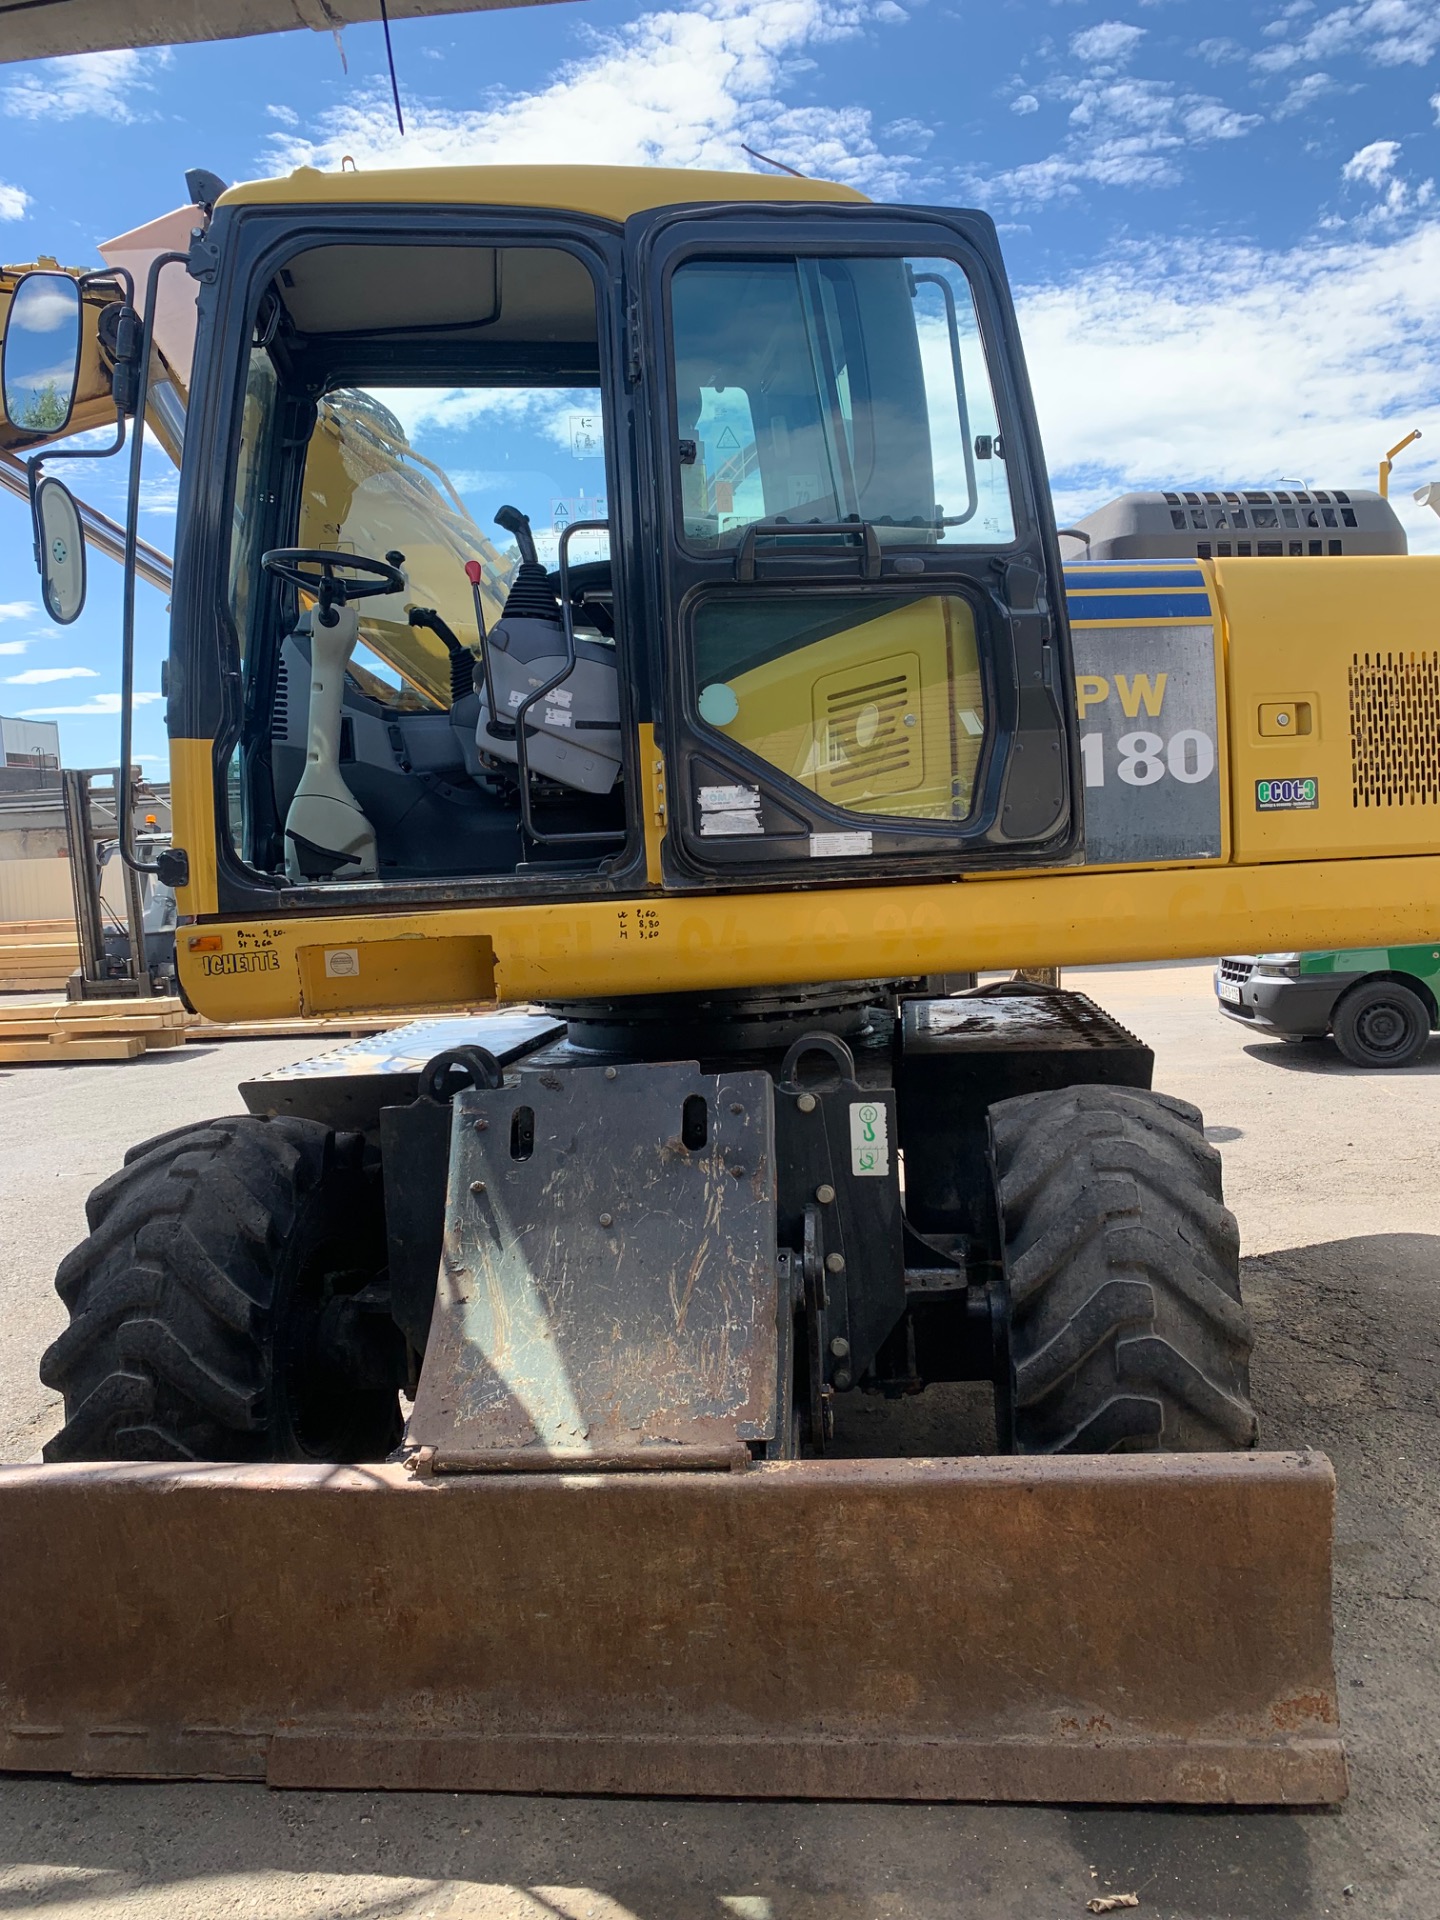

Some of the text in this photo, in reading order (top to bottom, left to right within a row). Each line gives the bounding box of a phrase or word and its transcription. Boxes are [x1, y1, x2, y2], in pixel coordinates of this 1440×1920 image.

[1075, 673, 1168, 719] PW
[1081, 729, 1215, 788] 180
[1257, 779, 1316, 803] ecot3
[619, 919, 660, 930] L 8,80
[619, 930, 659, 940] H 3,60
